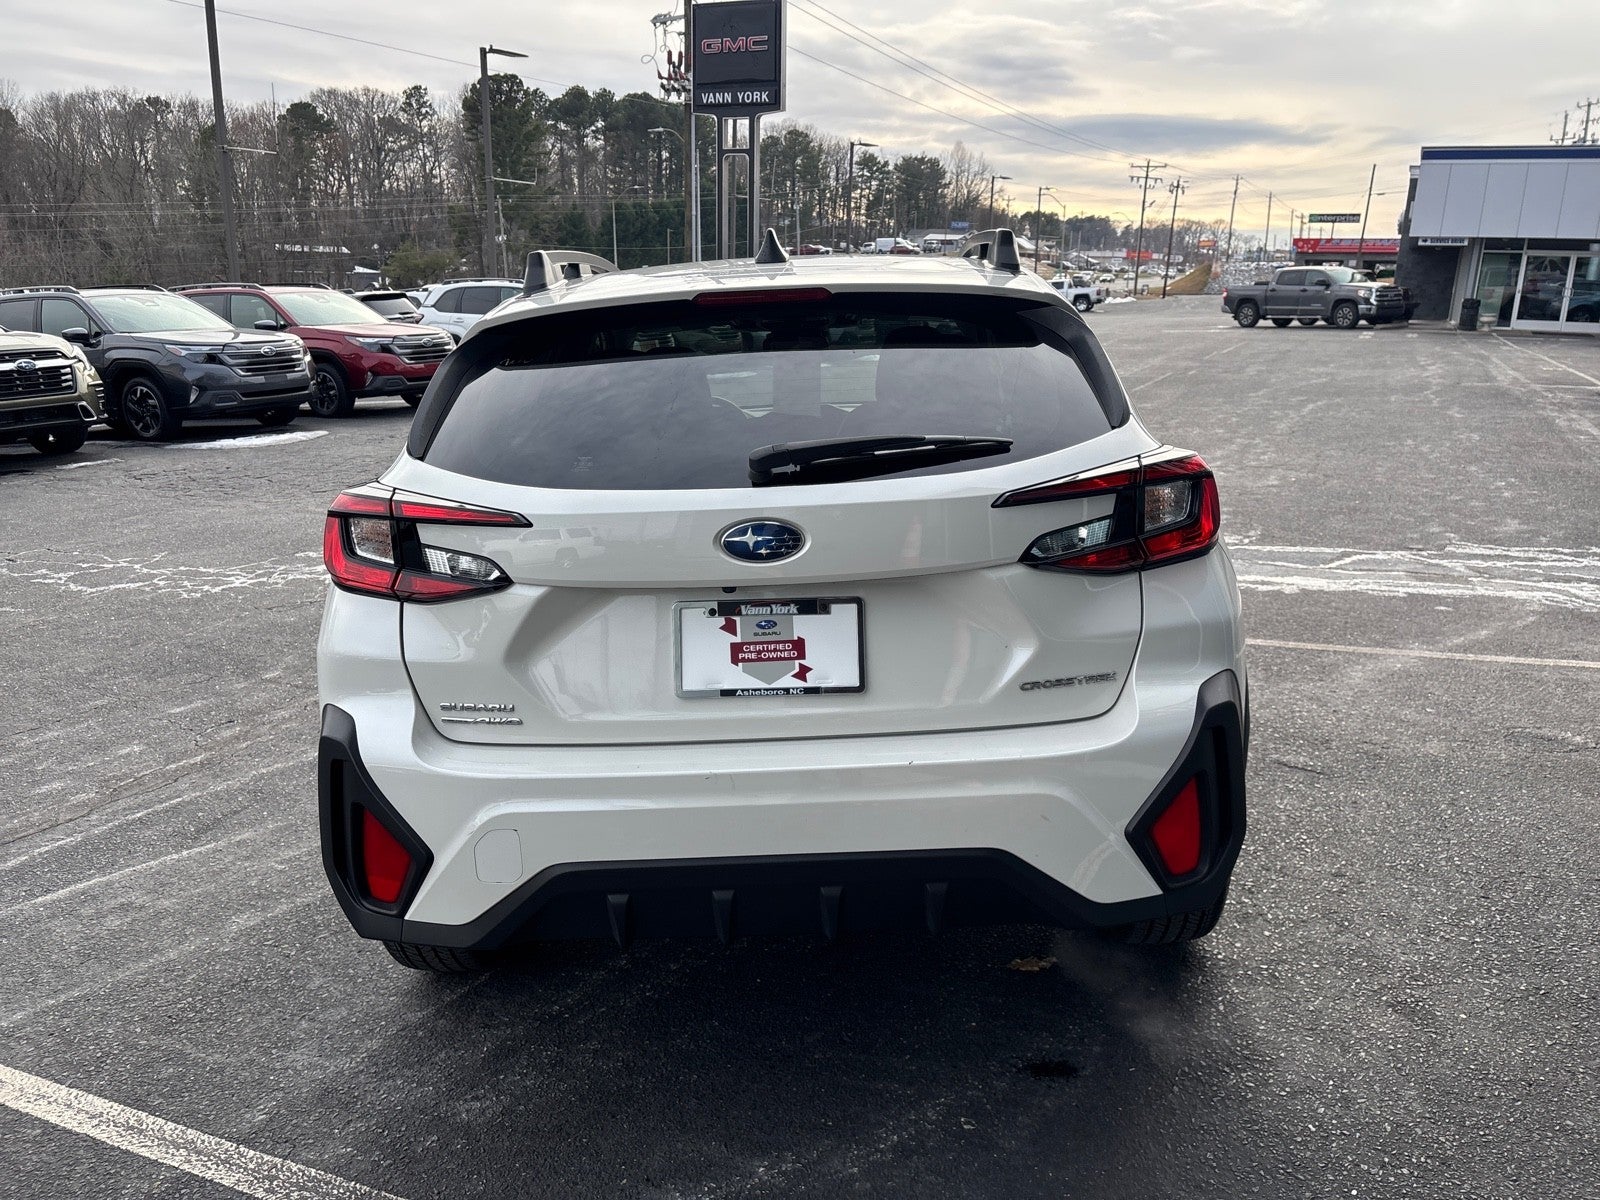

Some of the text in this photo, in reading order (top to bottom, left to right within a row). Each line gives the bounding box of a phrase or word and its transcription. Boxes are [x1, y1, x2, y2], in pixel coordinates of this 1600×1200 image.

[702, 36, 768, 54] GMC
[702, 91, 769, 104] VANN YORK
[1311, 215, 1360, 223] enterprise
[740, 604, 799, 615] Vann York
[743, 643, 793, 652] CERTIFIED
[738, 651, 798, 660] PRE-OWNED
[1020, 672, 1117, 691] CROSSTREK
[440, 702, 515, 712] SUBARU
[472, 717, 523, 725] AWD
